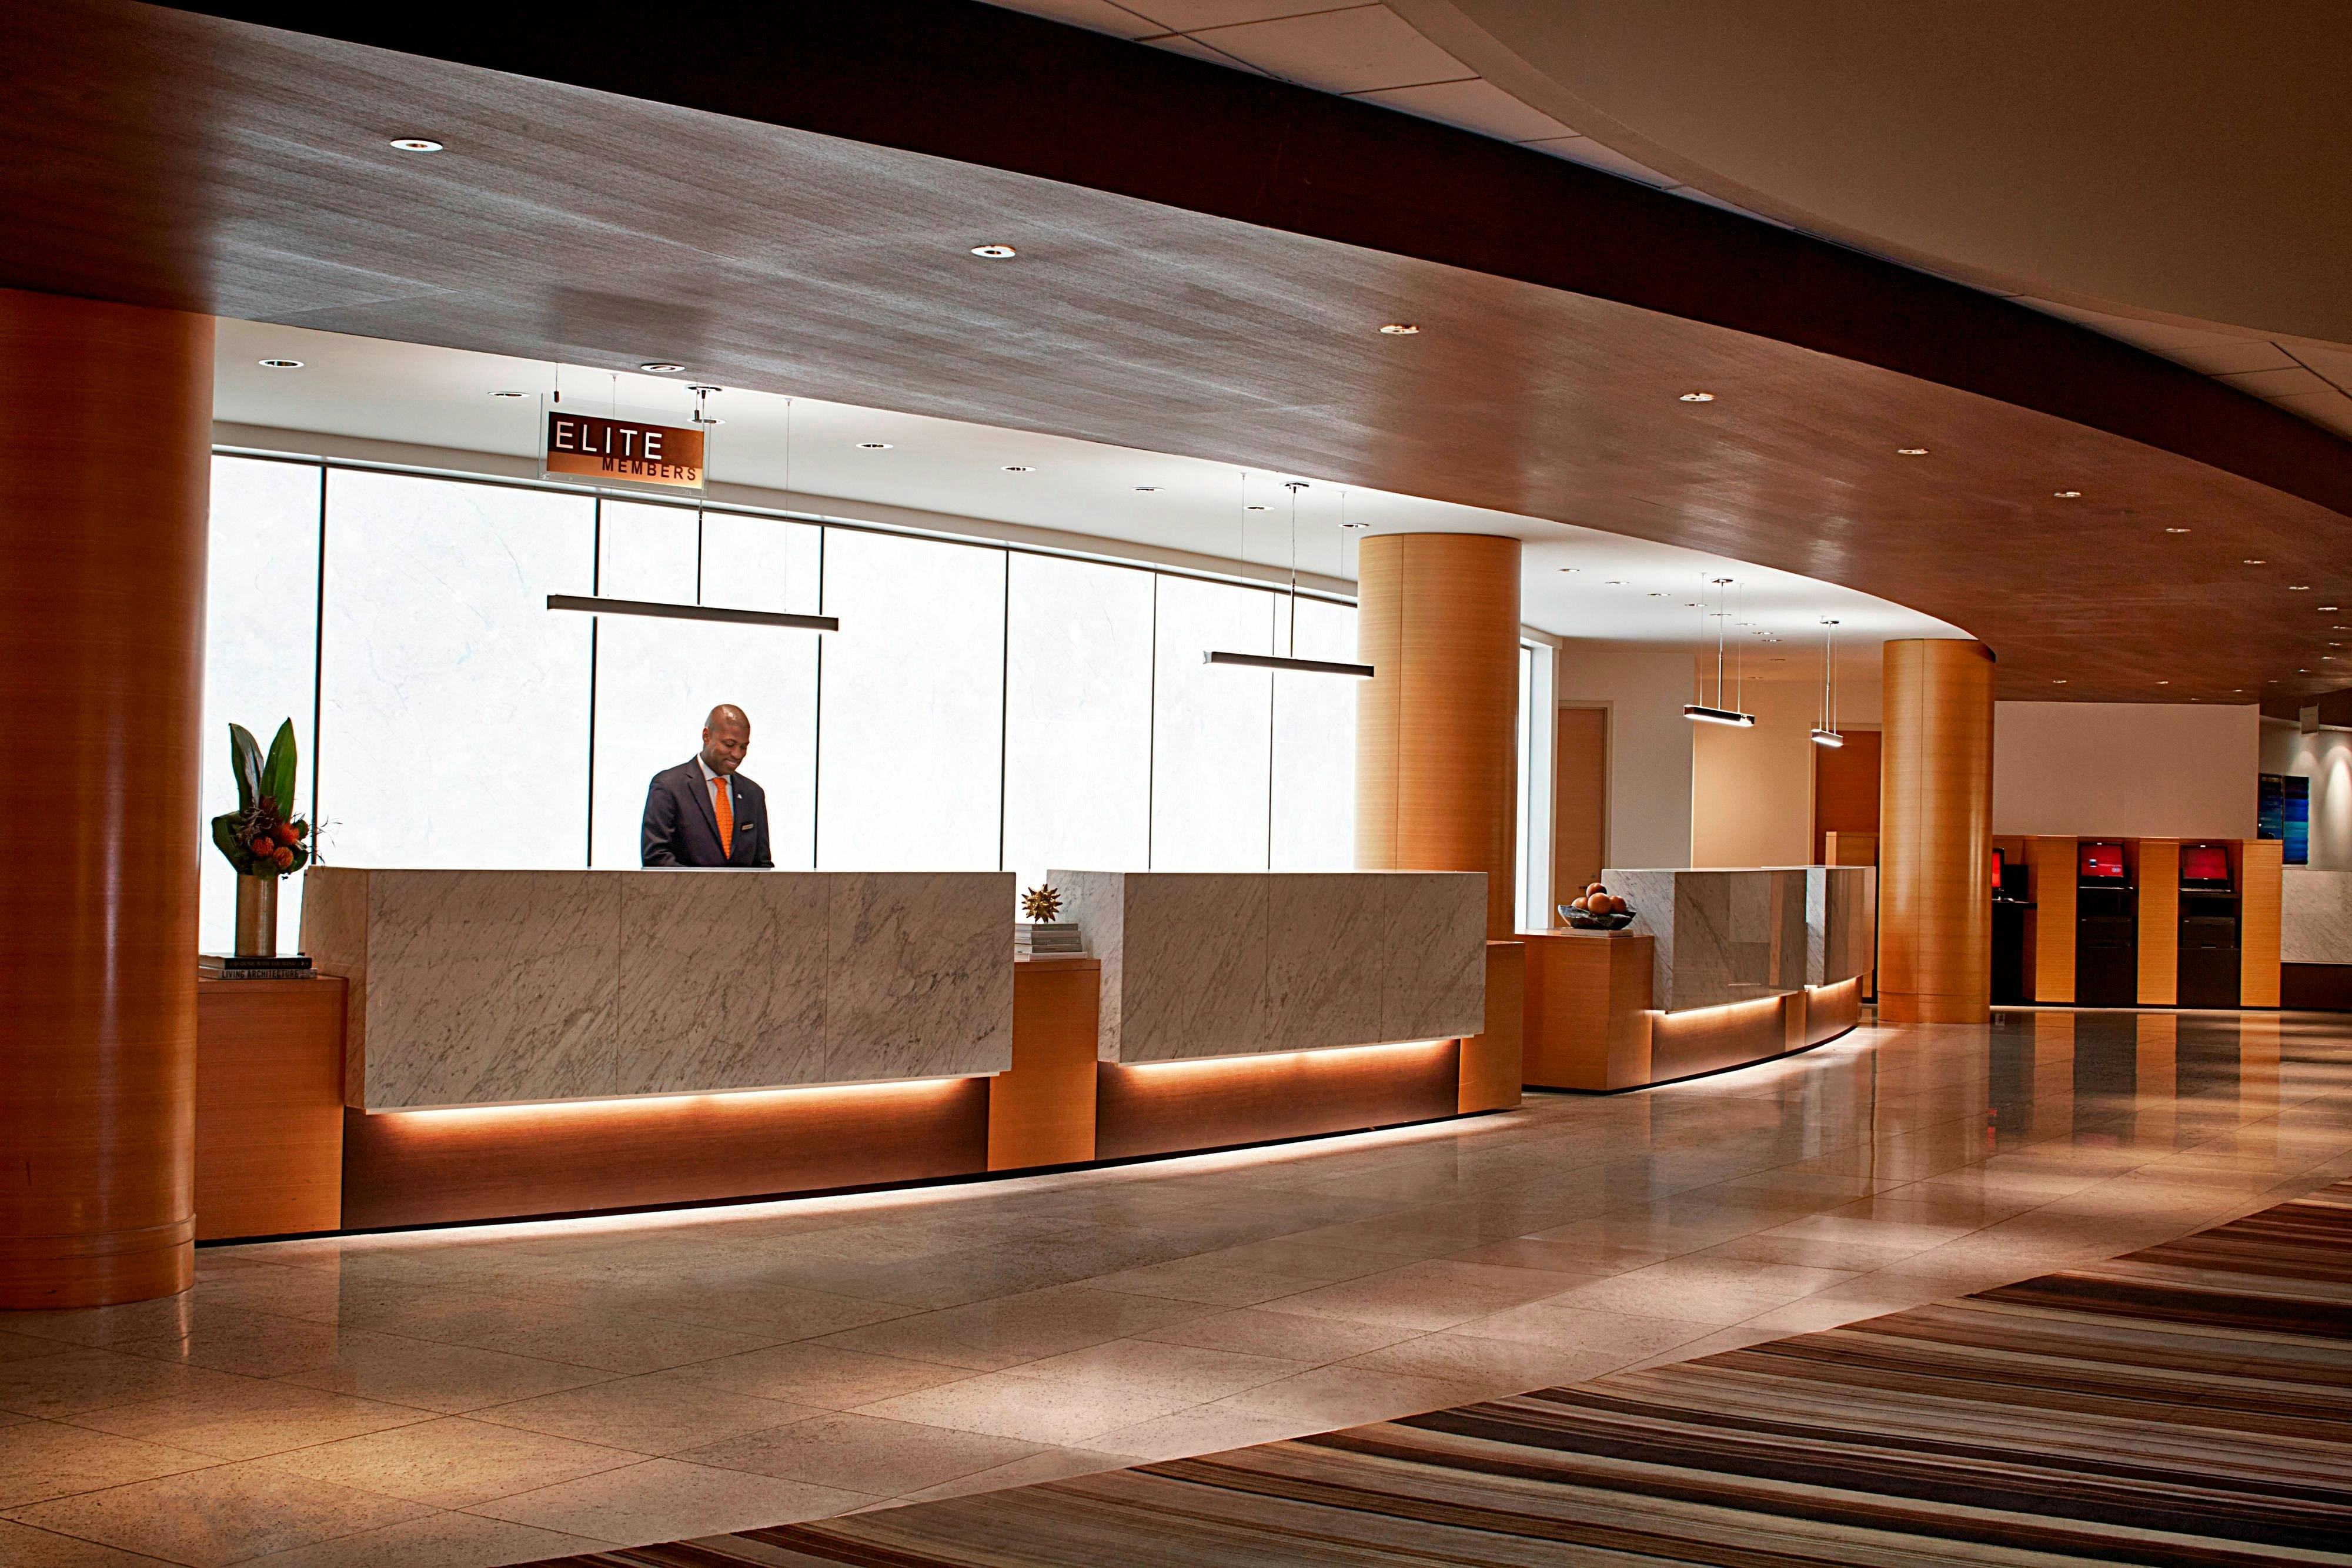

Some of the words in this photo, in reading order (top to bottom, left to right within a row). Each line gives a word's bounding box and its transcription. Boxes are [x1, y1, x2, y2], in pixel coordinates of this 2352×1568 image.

[556, 421, 662, 460] ELITE
[602, 457, 696, 481] MEMBERS
[222, 970, 245, 978] LIVING
[247, 969, 299, 978] ARCHITECTURE
